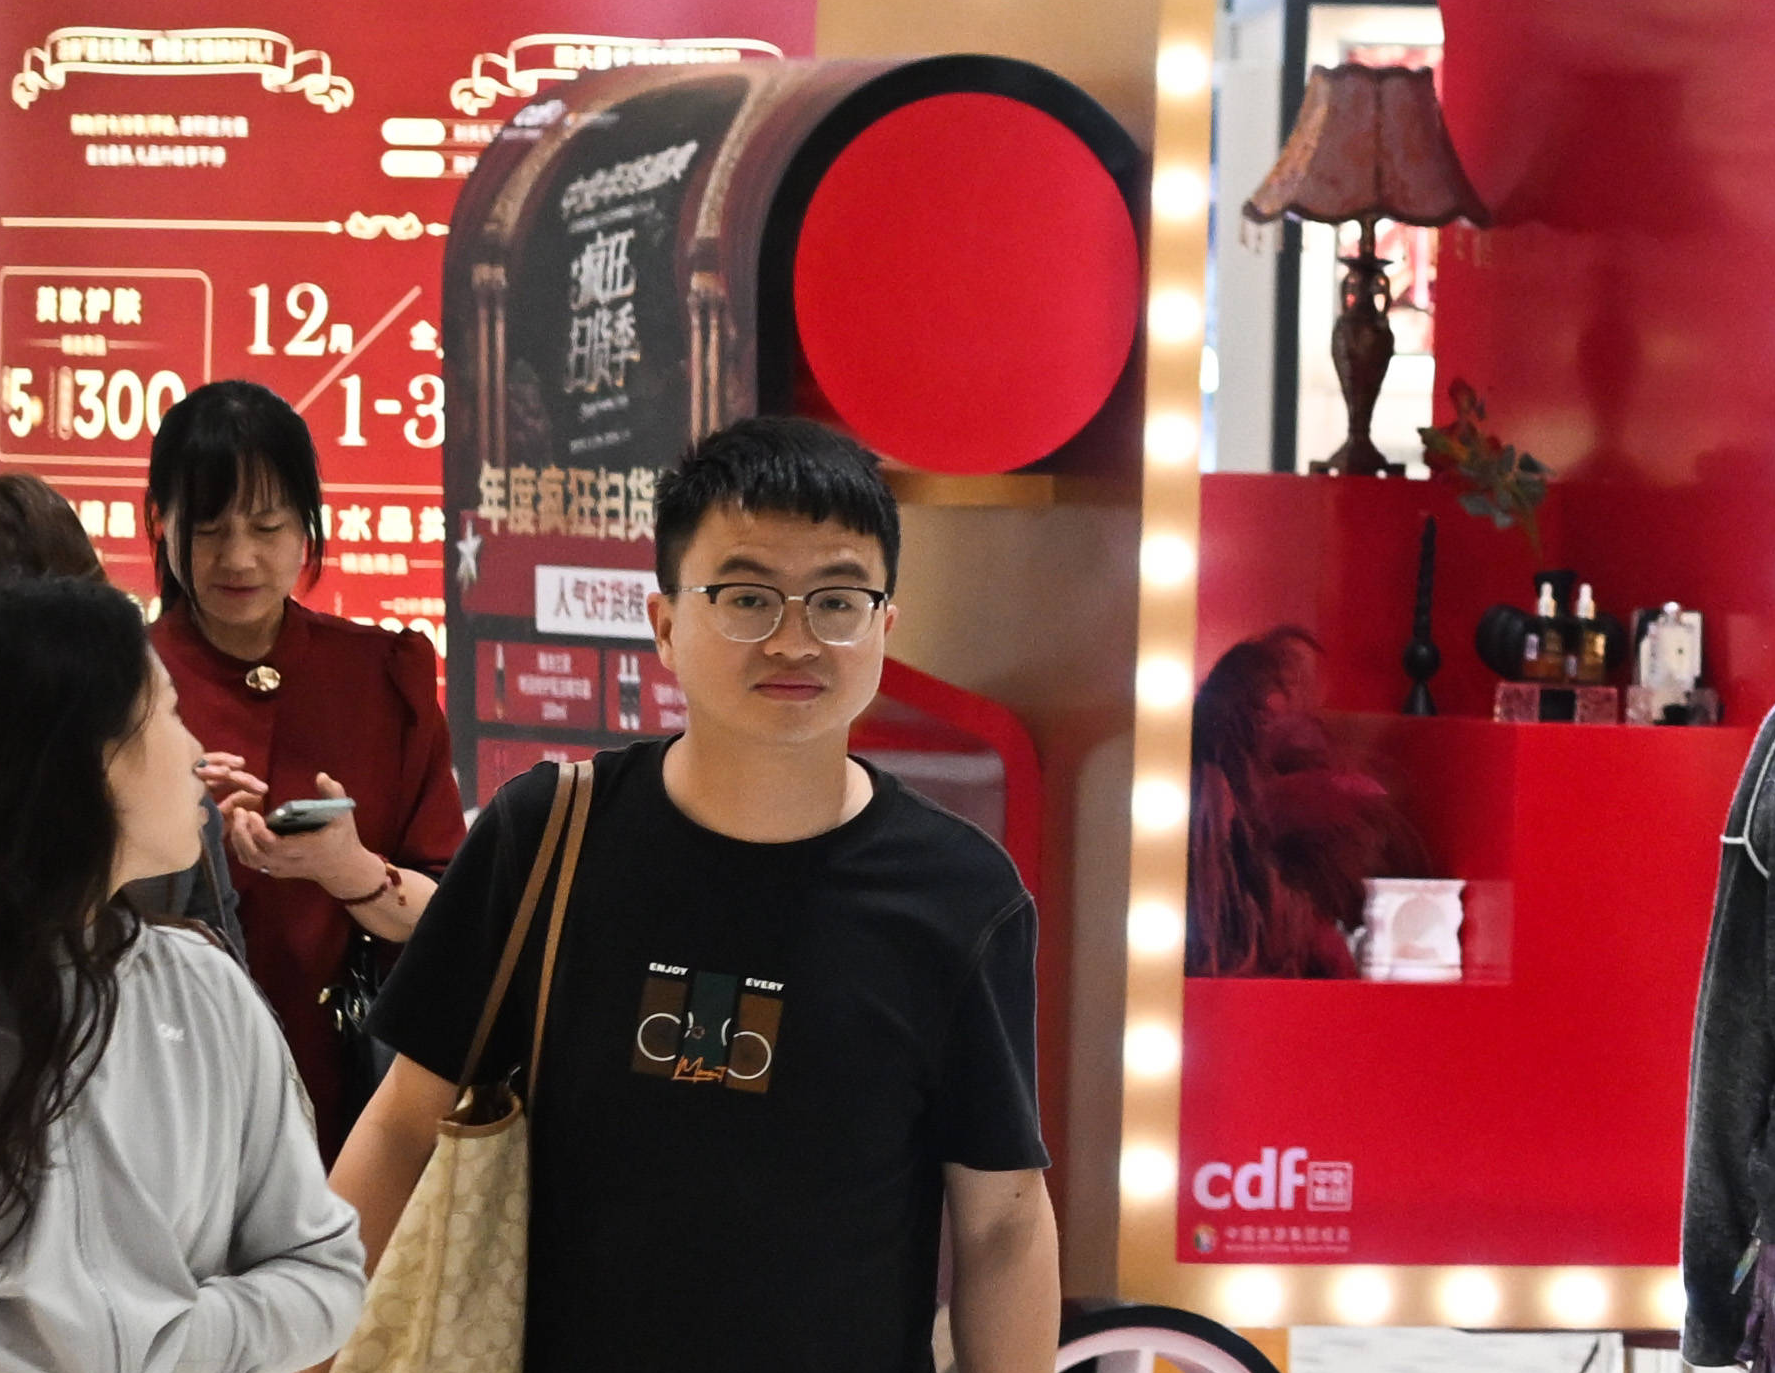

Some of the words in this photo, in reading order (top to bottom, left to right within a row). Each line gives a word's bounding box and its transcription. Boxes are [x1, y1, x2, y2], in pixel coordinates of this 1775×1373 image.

[478, 458, 671, 542] 年度疯狂扫货
[648, 962, 689, 977] ENJOY
[744, 977, 785, 993] EVERY
[1192, 1146, 1308, 1211] cdf
